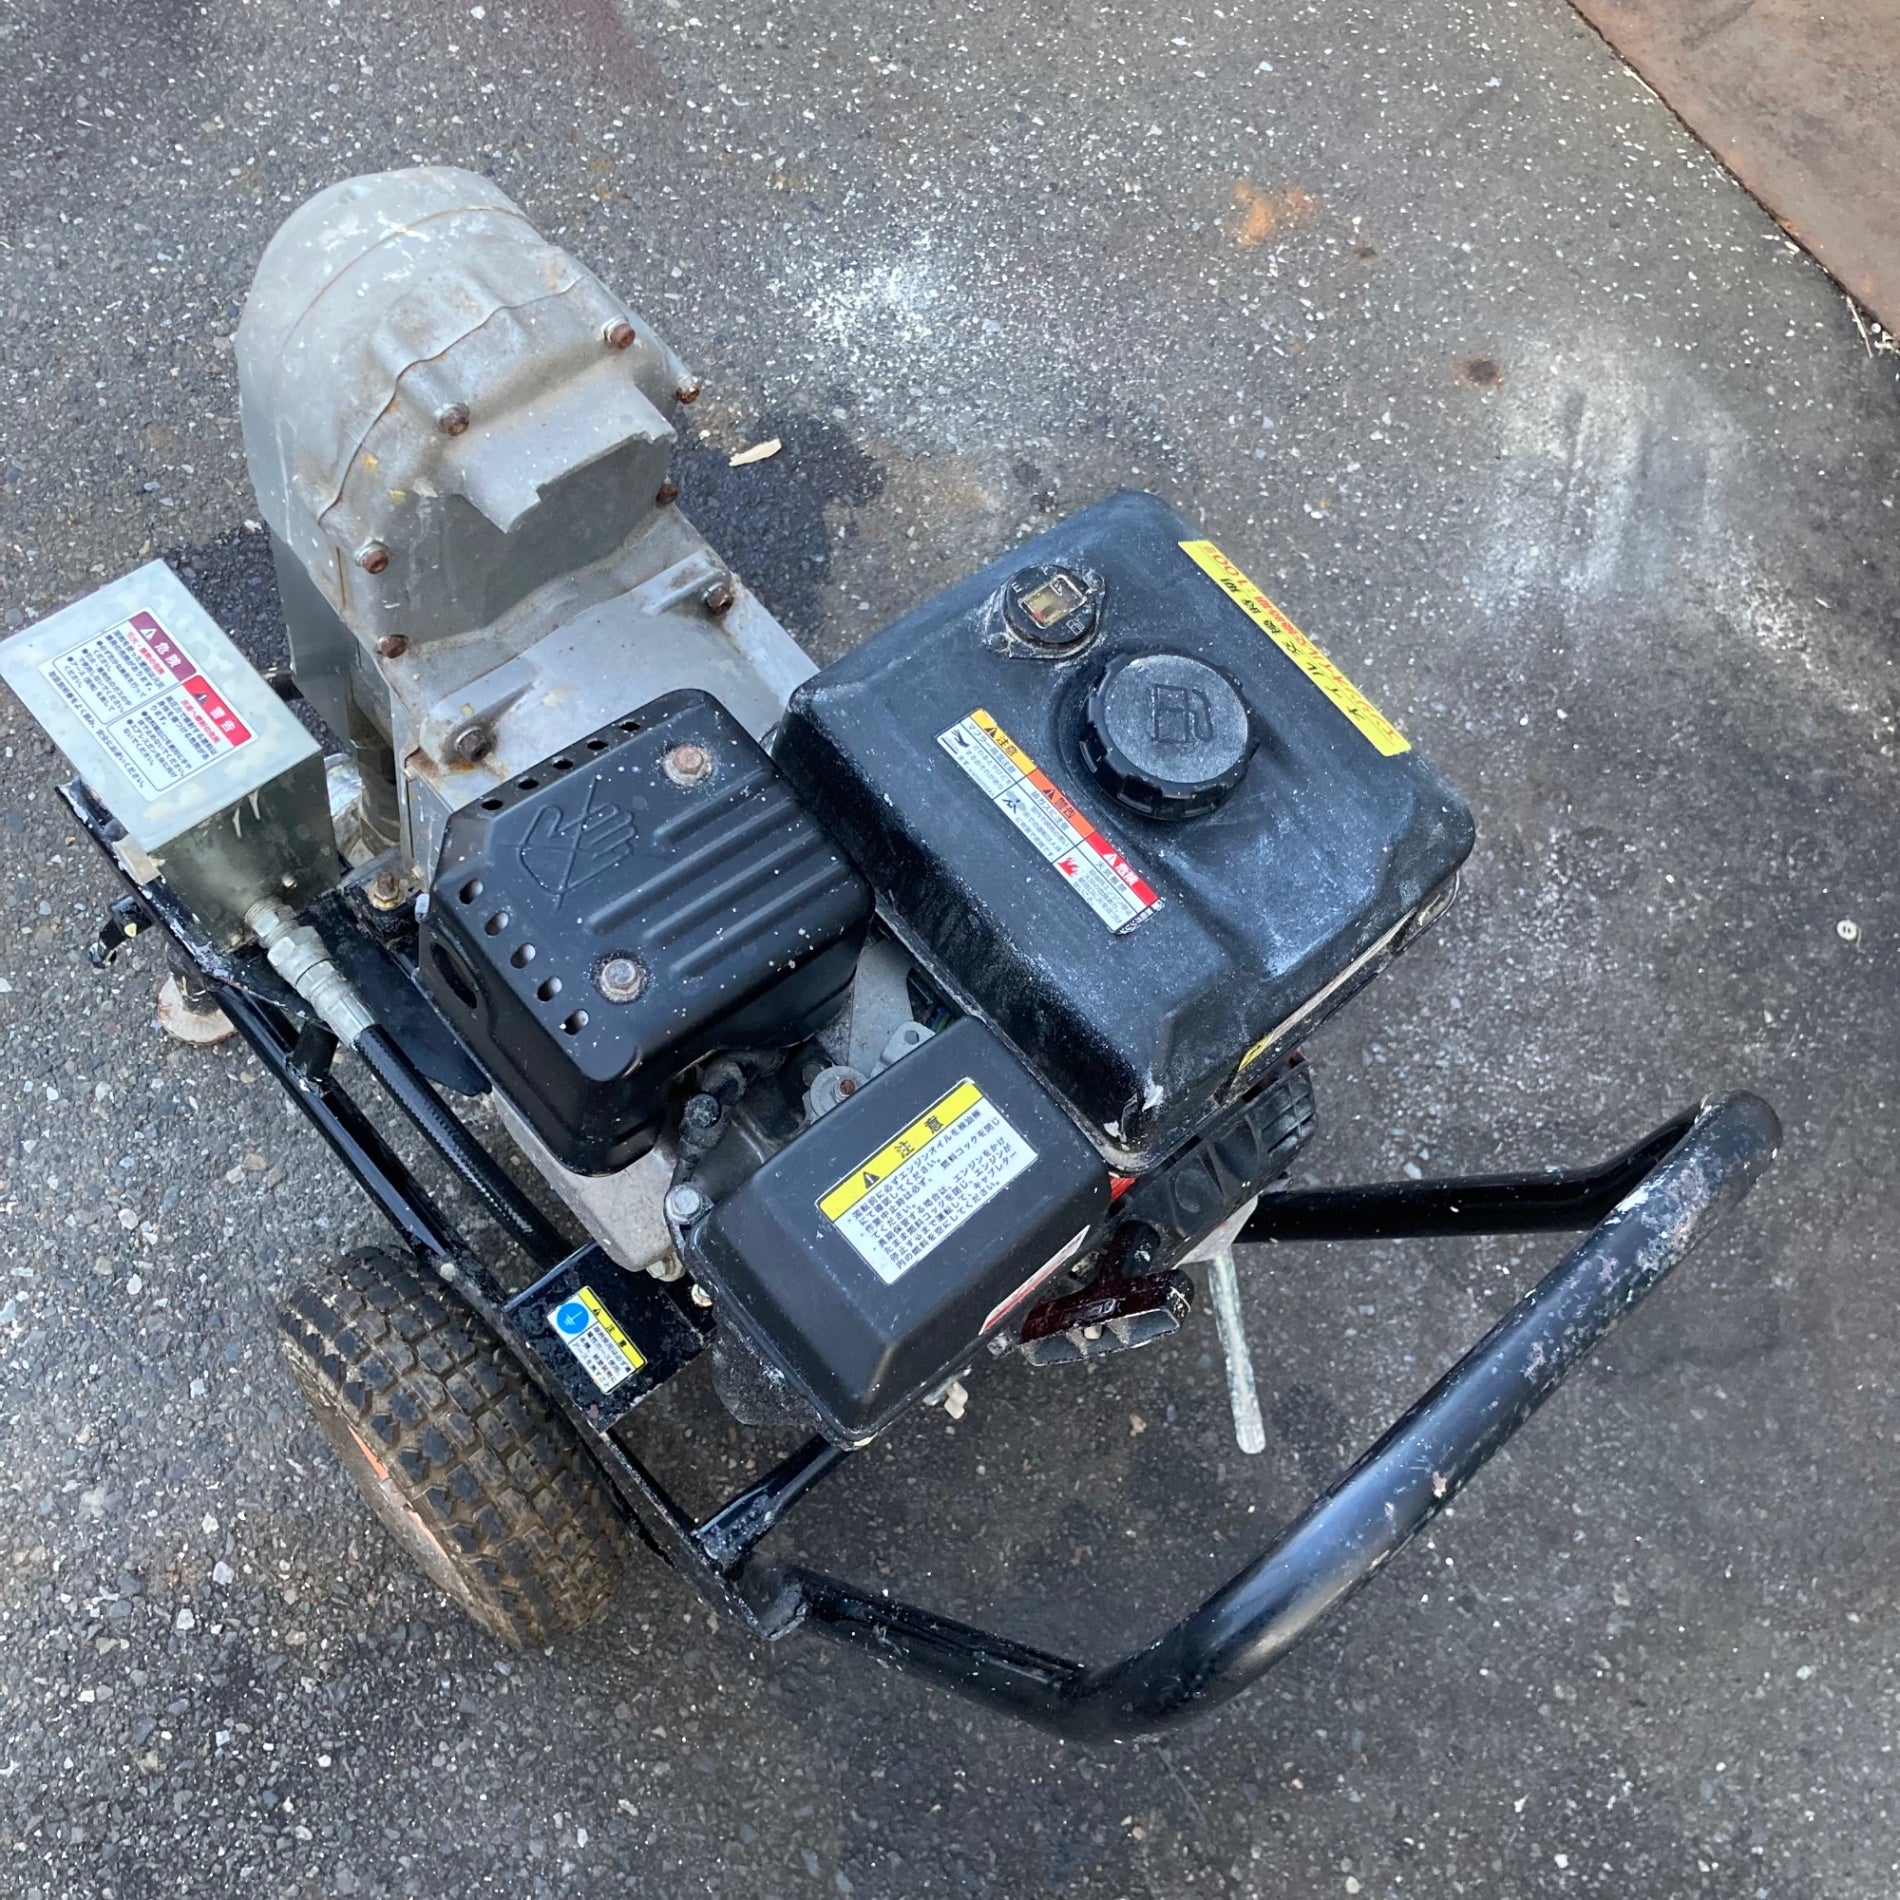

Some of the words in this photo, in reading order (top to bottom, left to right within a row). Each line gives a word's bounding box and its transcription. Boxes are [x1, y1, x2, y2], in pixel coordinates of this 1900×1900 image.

[91, 648, 113, 671] ください。
[154, 640, 183, 668] 危険
[1219, 578, 1365, 721] オイル交換時期
[62, 665, 84, 688] ください。
[149, 704, 169, 725] ります。
[208, 705, 237, 733] 警告
[122, 727, 156, 765] ないでください。
[995, 734, 1018, 756] 注意
[1053, 797, 1077, 819] 警告
[1095, 861, 1127, 893] 火気厳禁
[1113, 861, 1139, 886] 危険
[893, 1114, 943, 1158] 注意
[857, 1155, 941, 1226] にて確認してください。
[871, 1200, 916, 1239] てください。
[895, 1177, 1000, 1269] 内の燃料を空にしてください。
